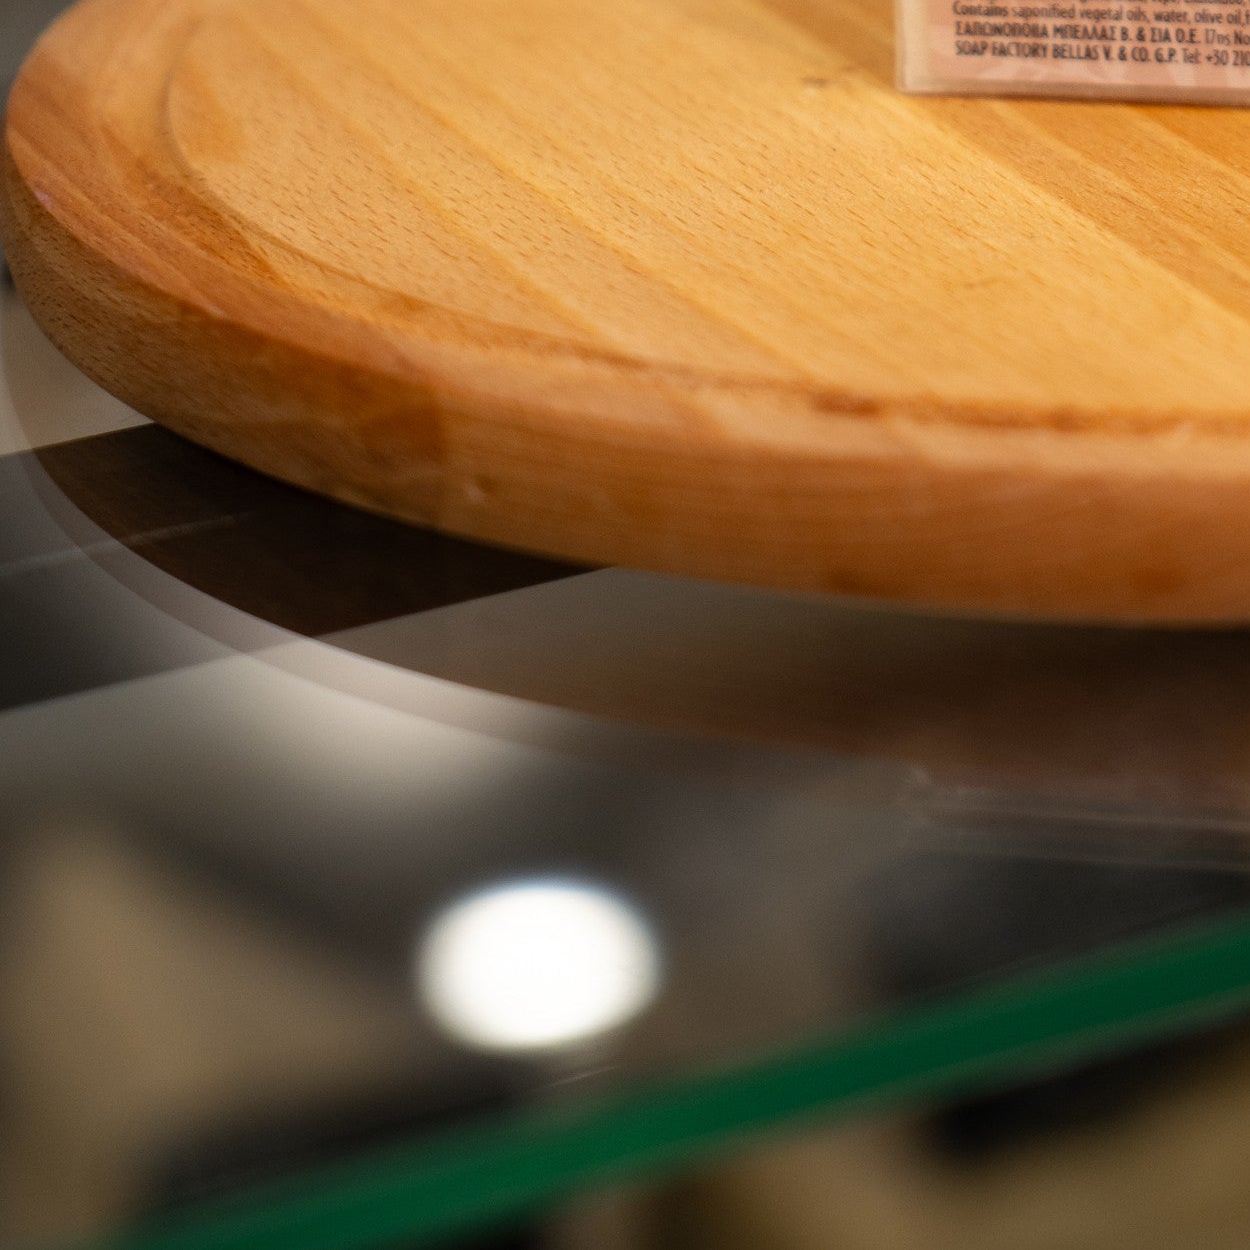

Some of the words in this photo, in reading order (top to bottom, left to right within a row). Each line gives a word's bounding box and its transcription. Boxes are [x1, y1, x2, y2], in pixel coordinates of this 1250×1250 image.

[953, 0, 1008, 18] Contains
[1012, 3, 1075, 21] saponified
[1079, 4, 1122, 24] vegetal
[1154, 10, 1191, 25] water,
[1194, 7, 1223, 25] olive
[1136, 26, 1146, 43] &
[955, 40, 988, 57] SOAP
[991, 41, 1048, 58] FACTORY
[1053, 43, 1099, 61] BELLAS
[1118, 45, 1127, 62] &
[1206, 49, 1229, 66] +30
